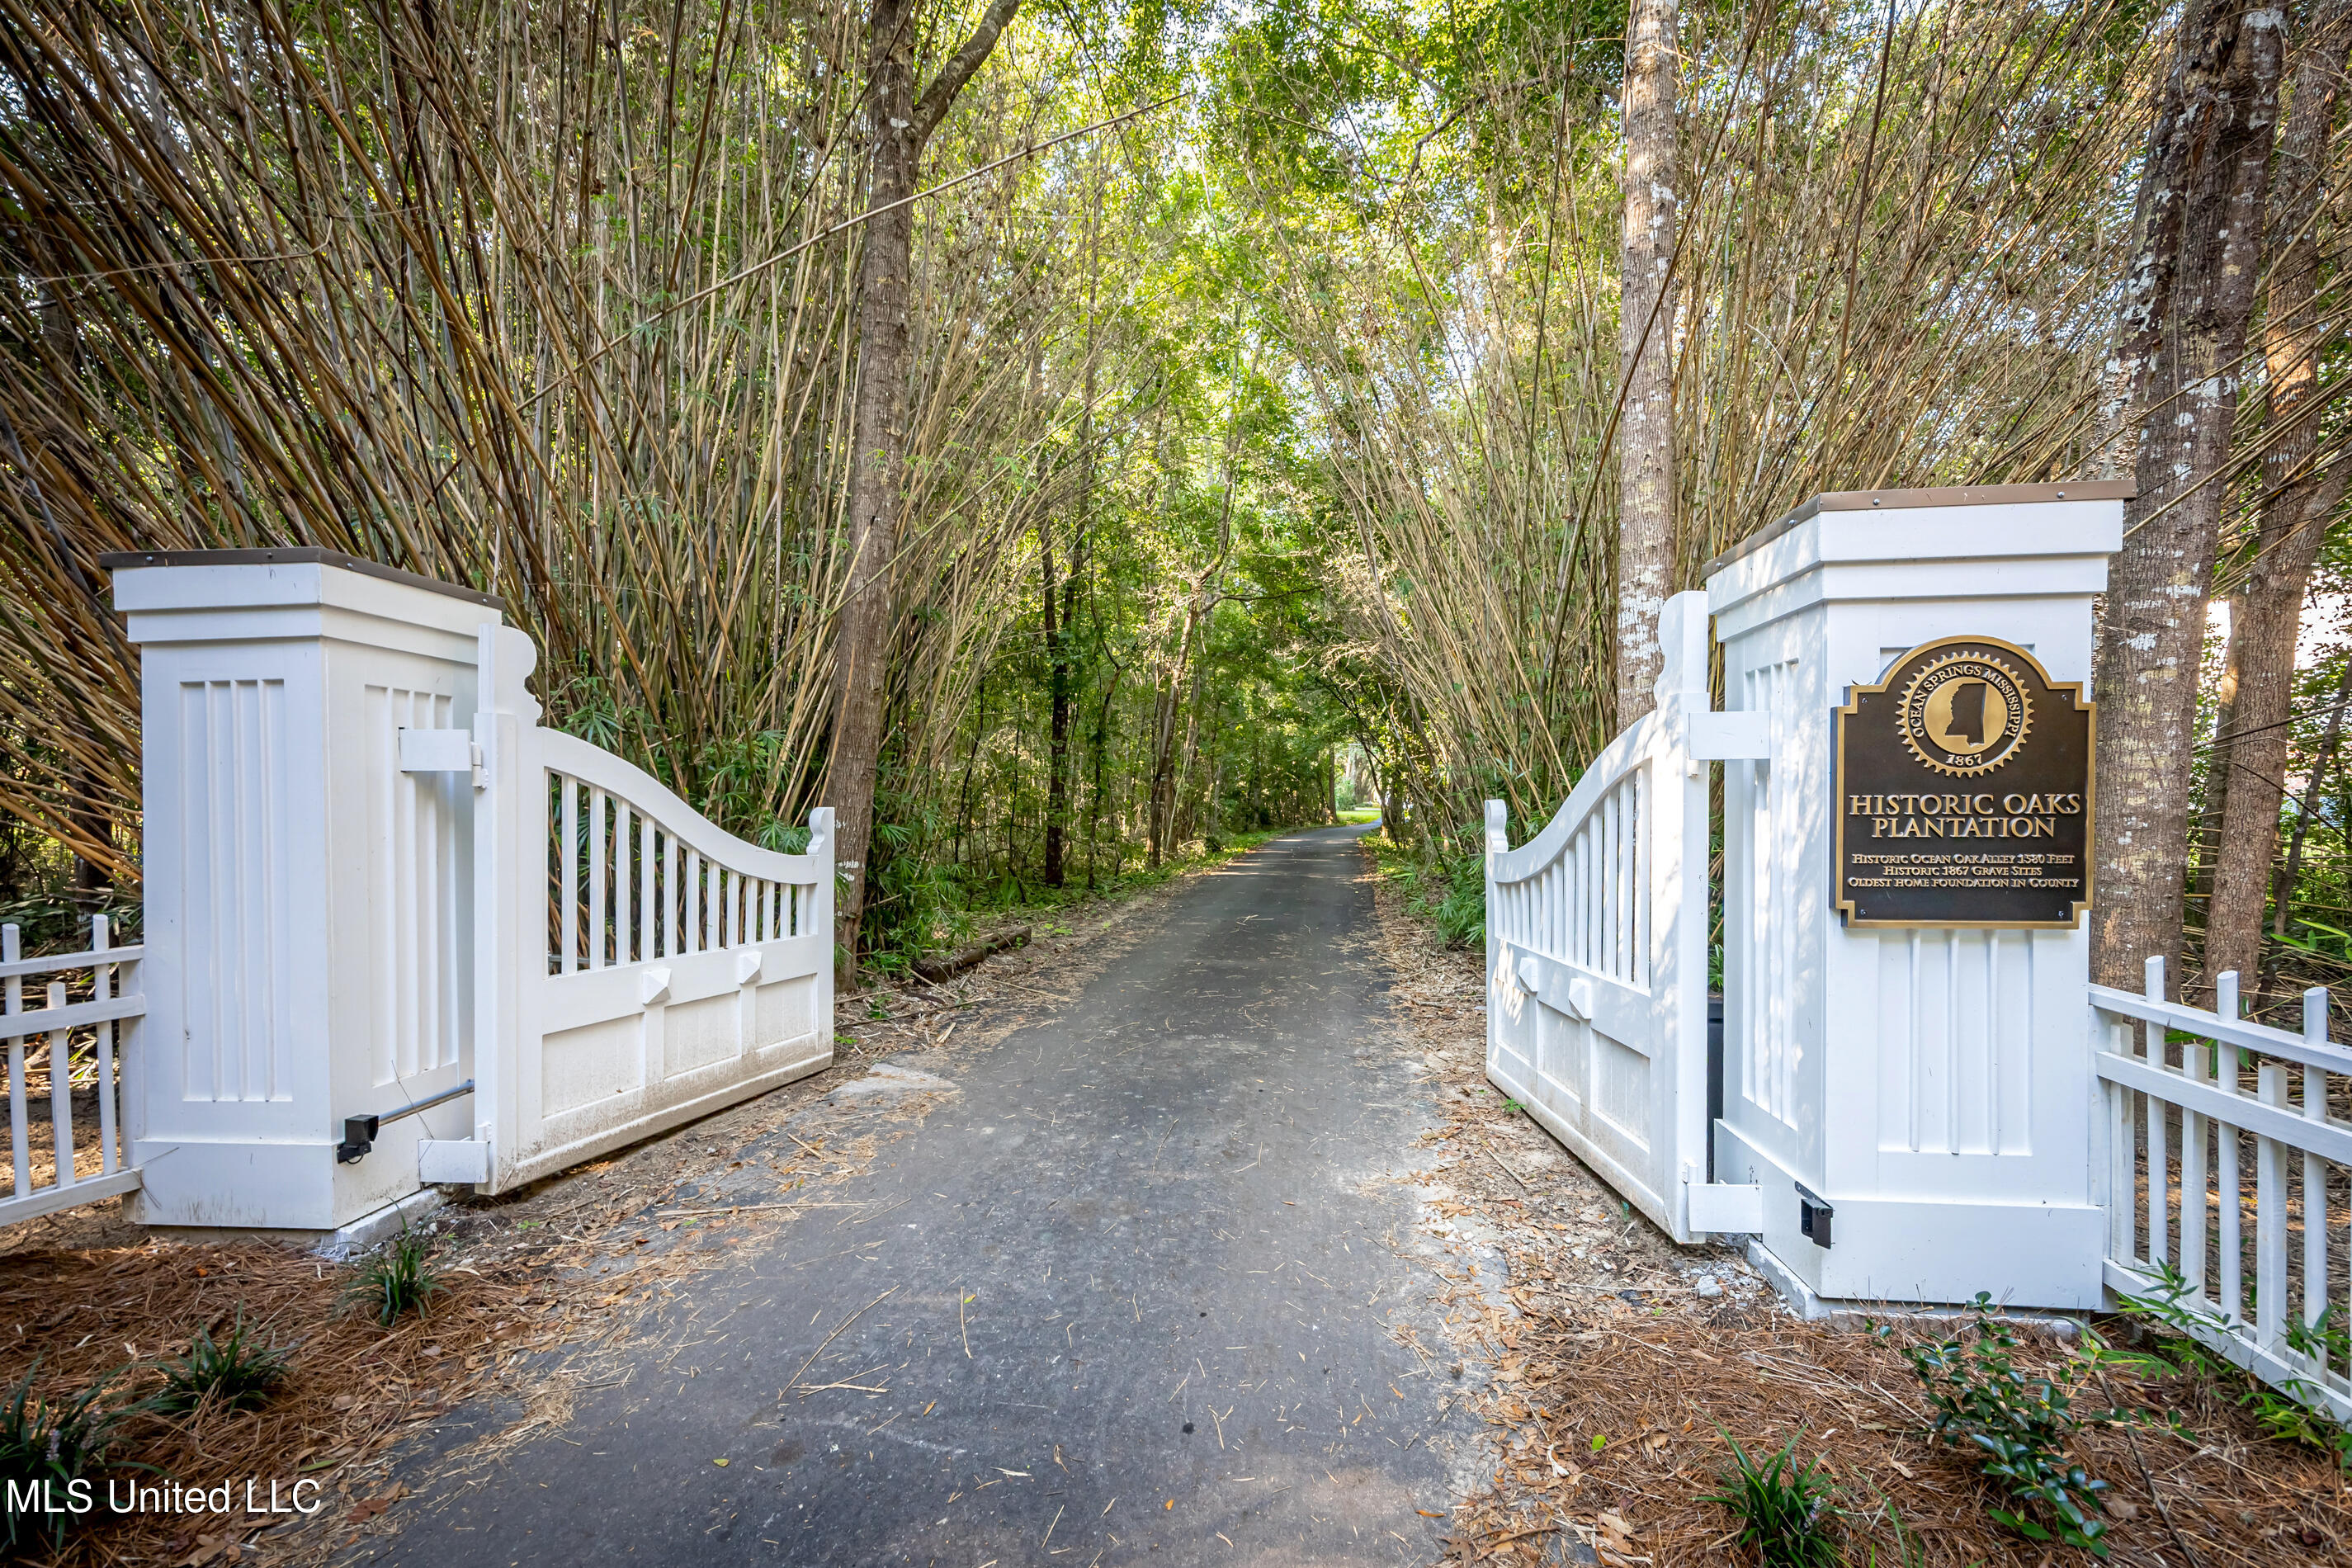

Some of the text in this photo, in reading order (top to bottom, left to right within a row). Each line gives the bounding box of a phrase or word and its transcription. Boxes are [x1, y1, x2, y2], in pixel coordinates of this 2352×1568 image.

[1910, 664, 2021, 739] OCEAN SPRINGS MISSISSIPPI
[1946, 754, 1982, 766] 1867
[1849, 793, 2080, 815] HISTORIC OAKS
[1871, 816, 2057, 838] PLANTATION
